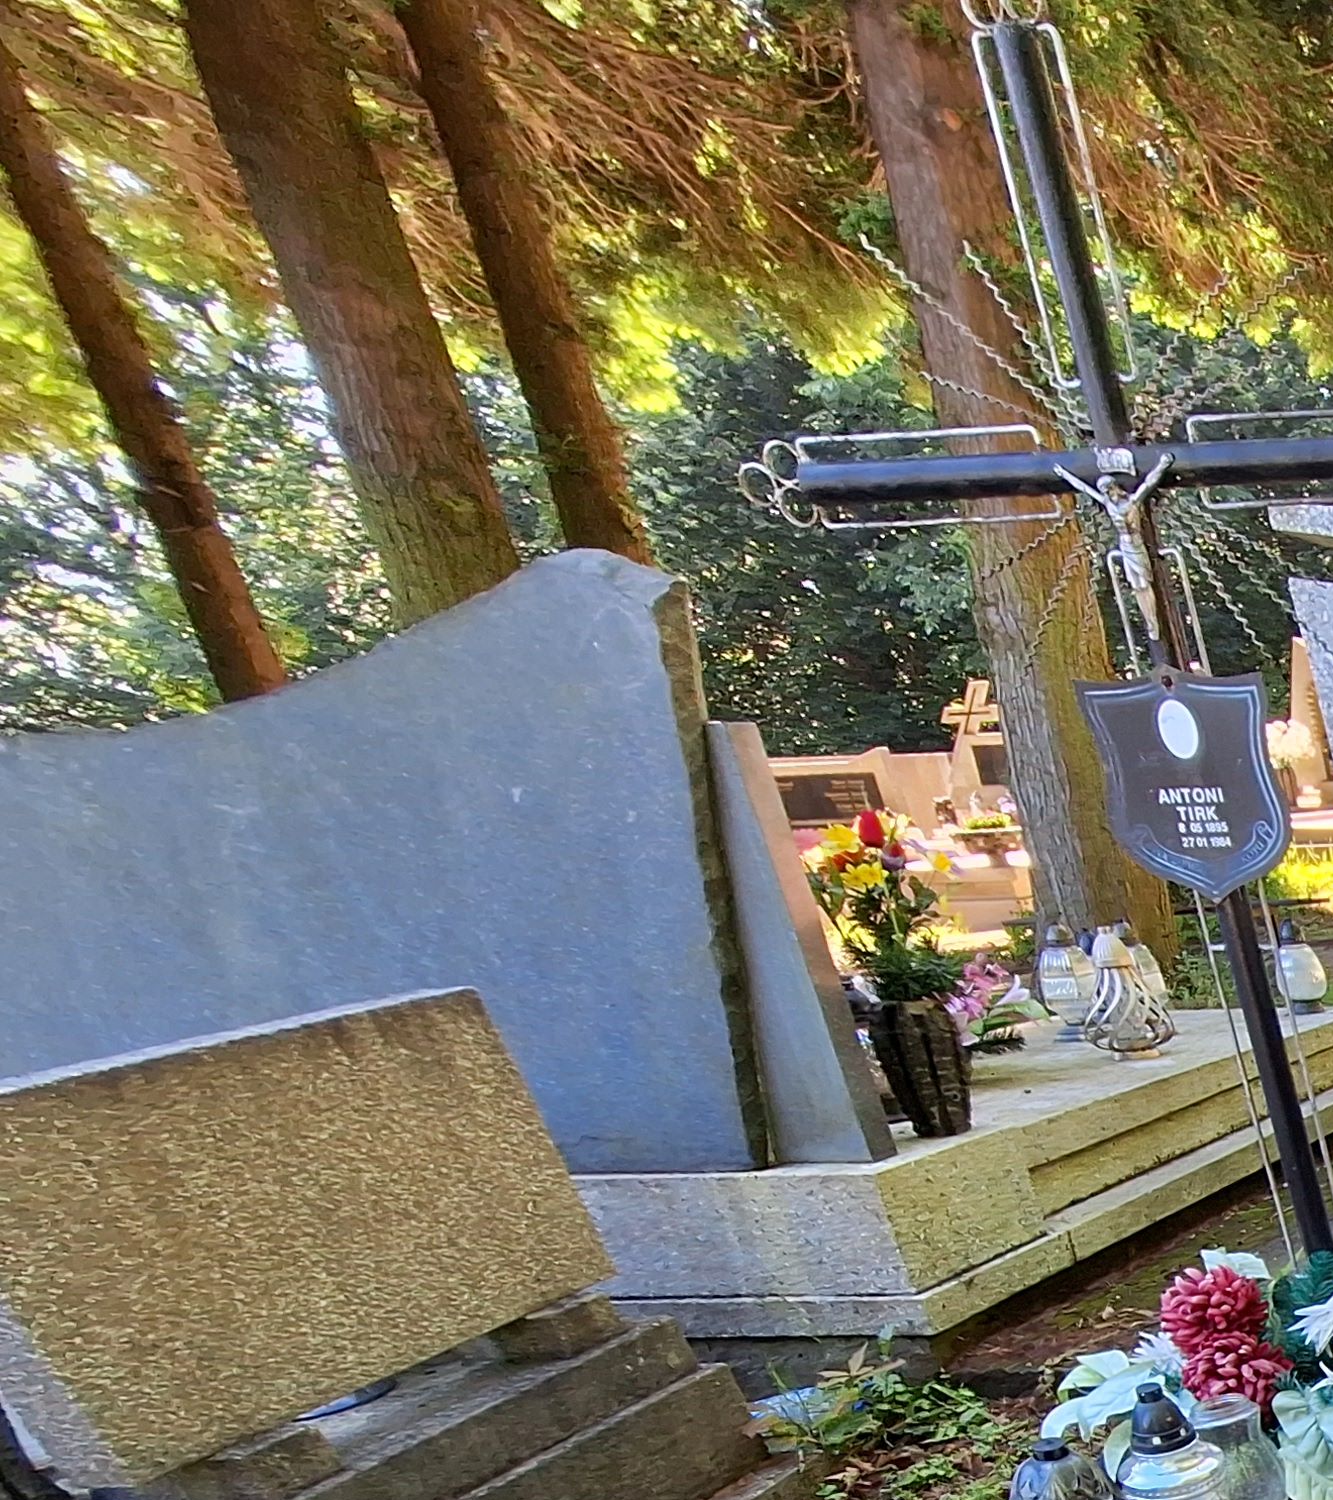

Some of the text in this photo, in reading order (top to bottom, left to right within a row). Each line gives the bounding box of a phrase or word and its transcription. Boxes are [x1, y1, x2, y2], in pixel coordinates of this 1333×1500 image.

[1159, 787, 1224, 804] ANTONI
[1176, 806, 1219, 821] TIRK
[1178, 822, 1186, 833] 8
[1190, 822, 1203, 833] 05
[1181, 836, 1232, 848] 27 01 1984
